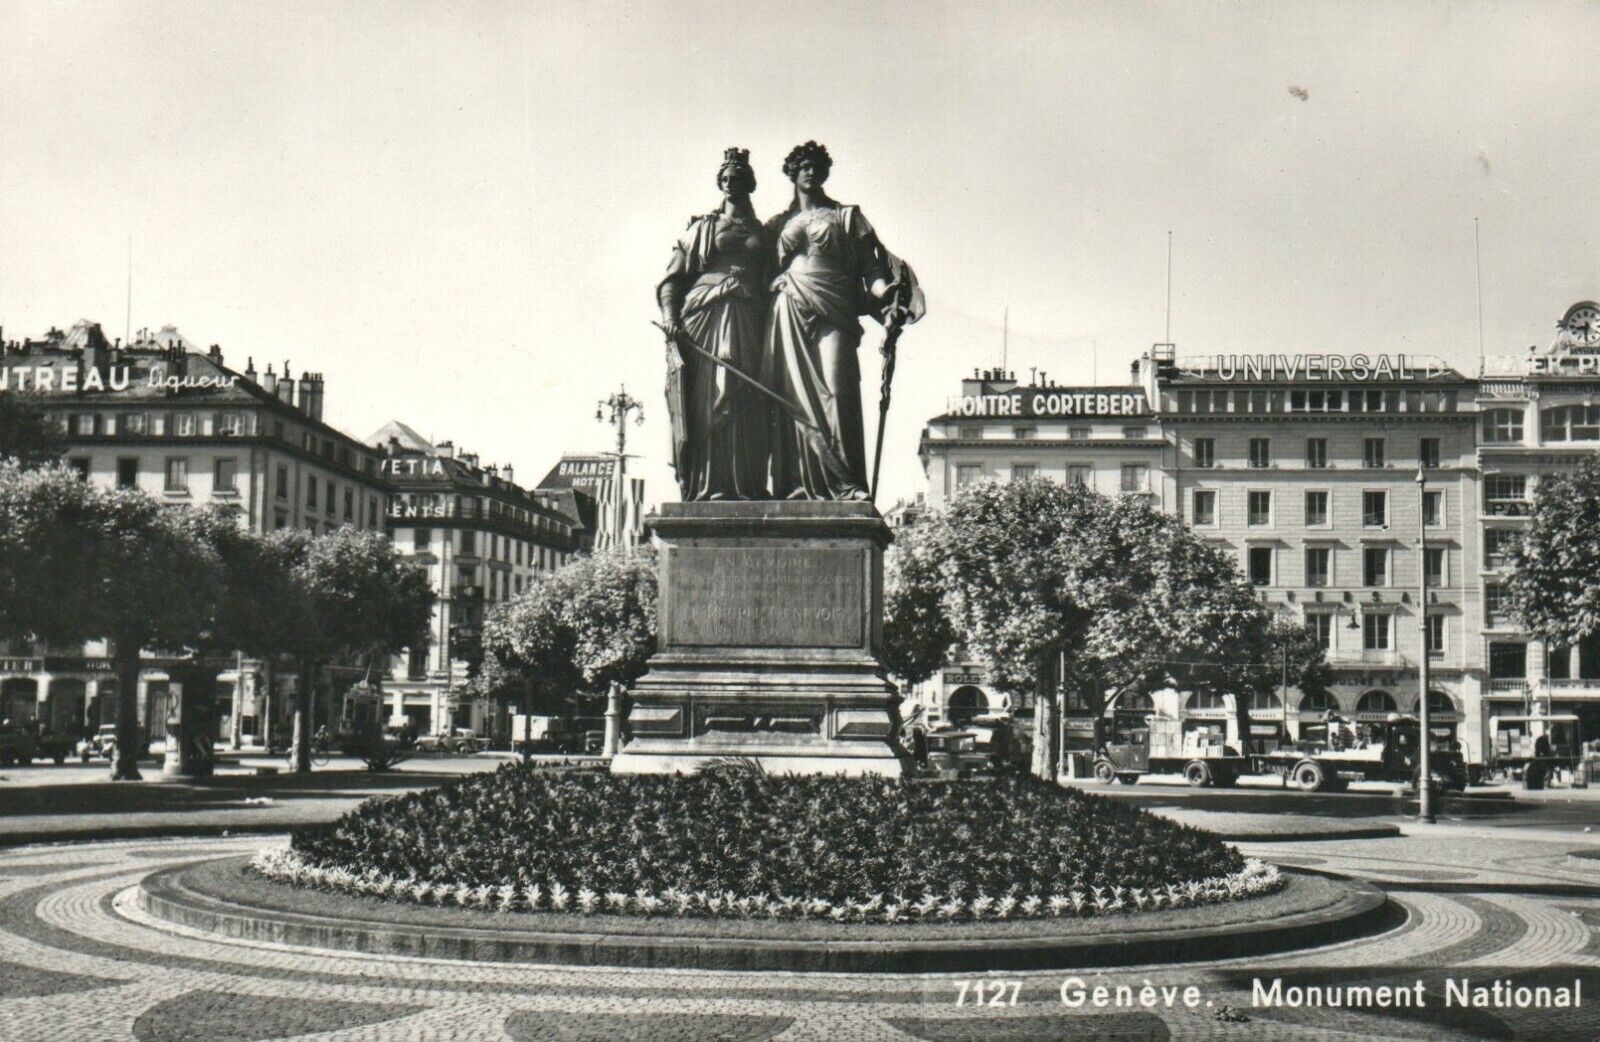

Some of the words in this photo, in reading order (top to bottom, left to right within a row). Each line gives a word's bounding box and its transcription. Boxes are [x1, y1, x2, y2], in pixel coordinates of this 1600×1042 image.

[1217, 354, 1415, 382] UNIVERSAL
[947, 394, 1022, 417] MONTRE
[1032, 394, 1145, 416] CORTEBERT
[559, 462, 615, 477] BALANCE
[386, 505, 446, 518] ENTS
